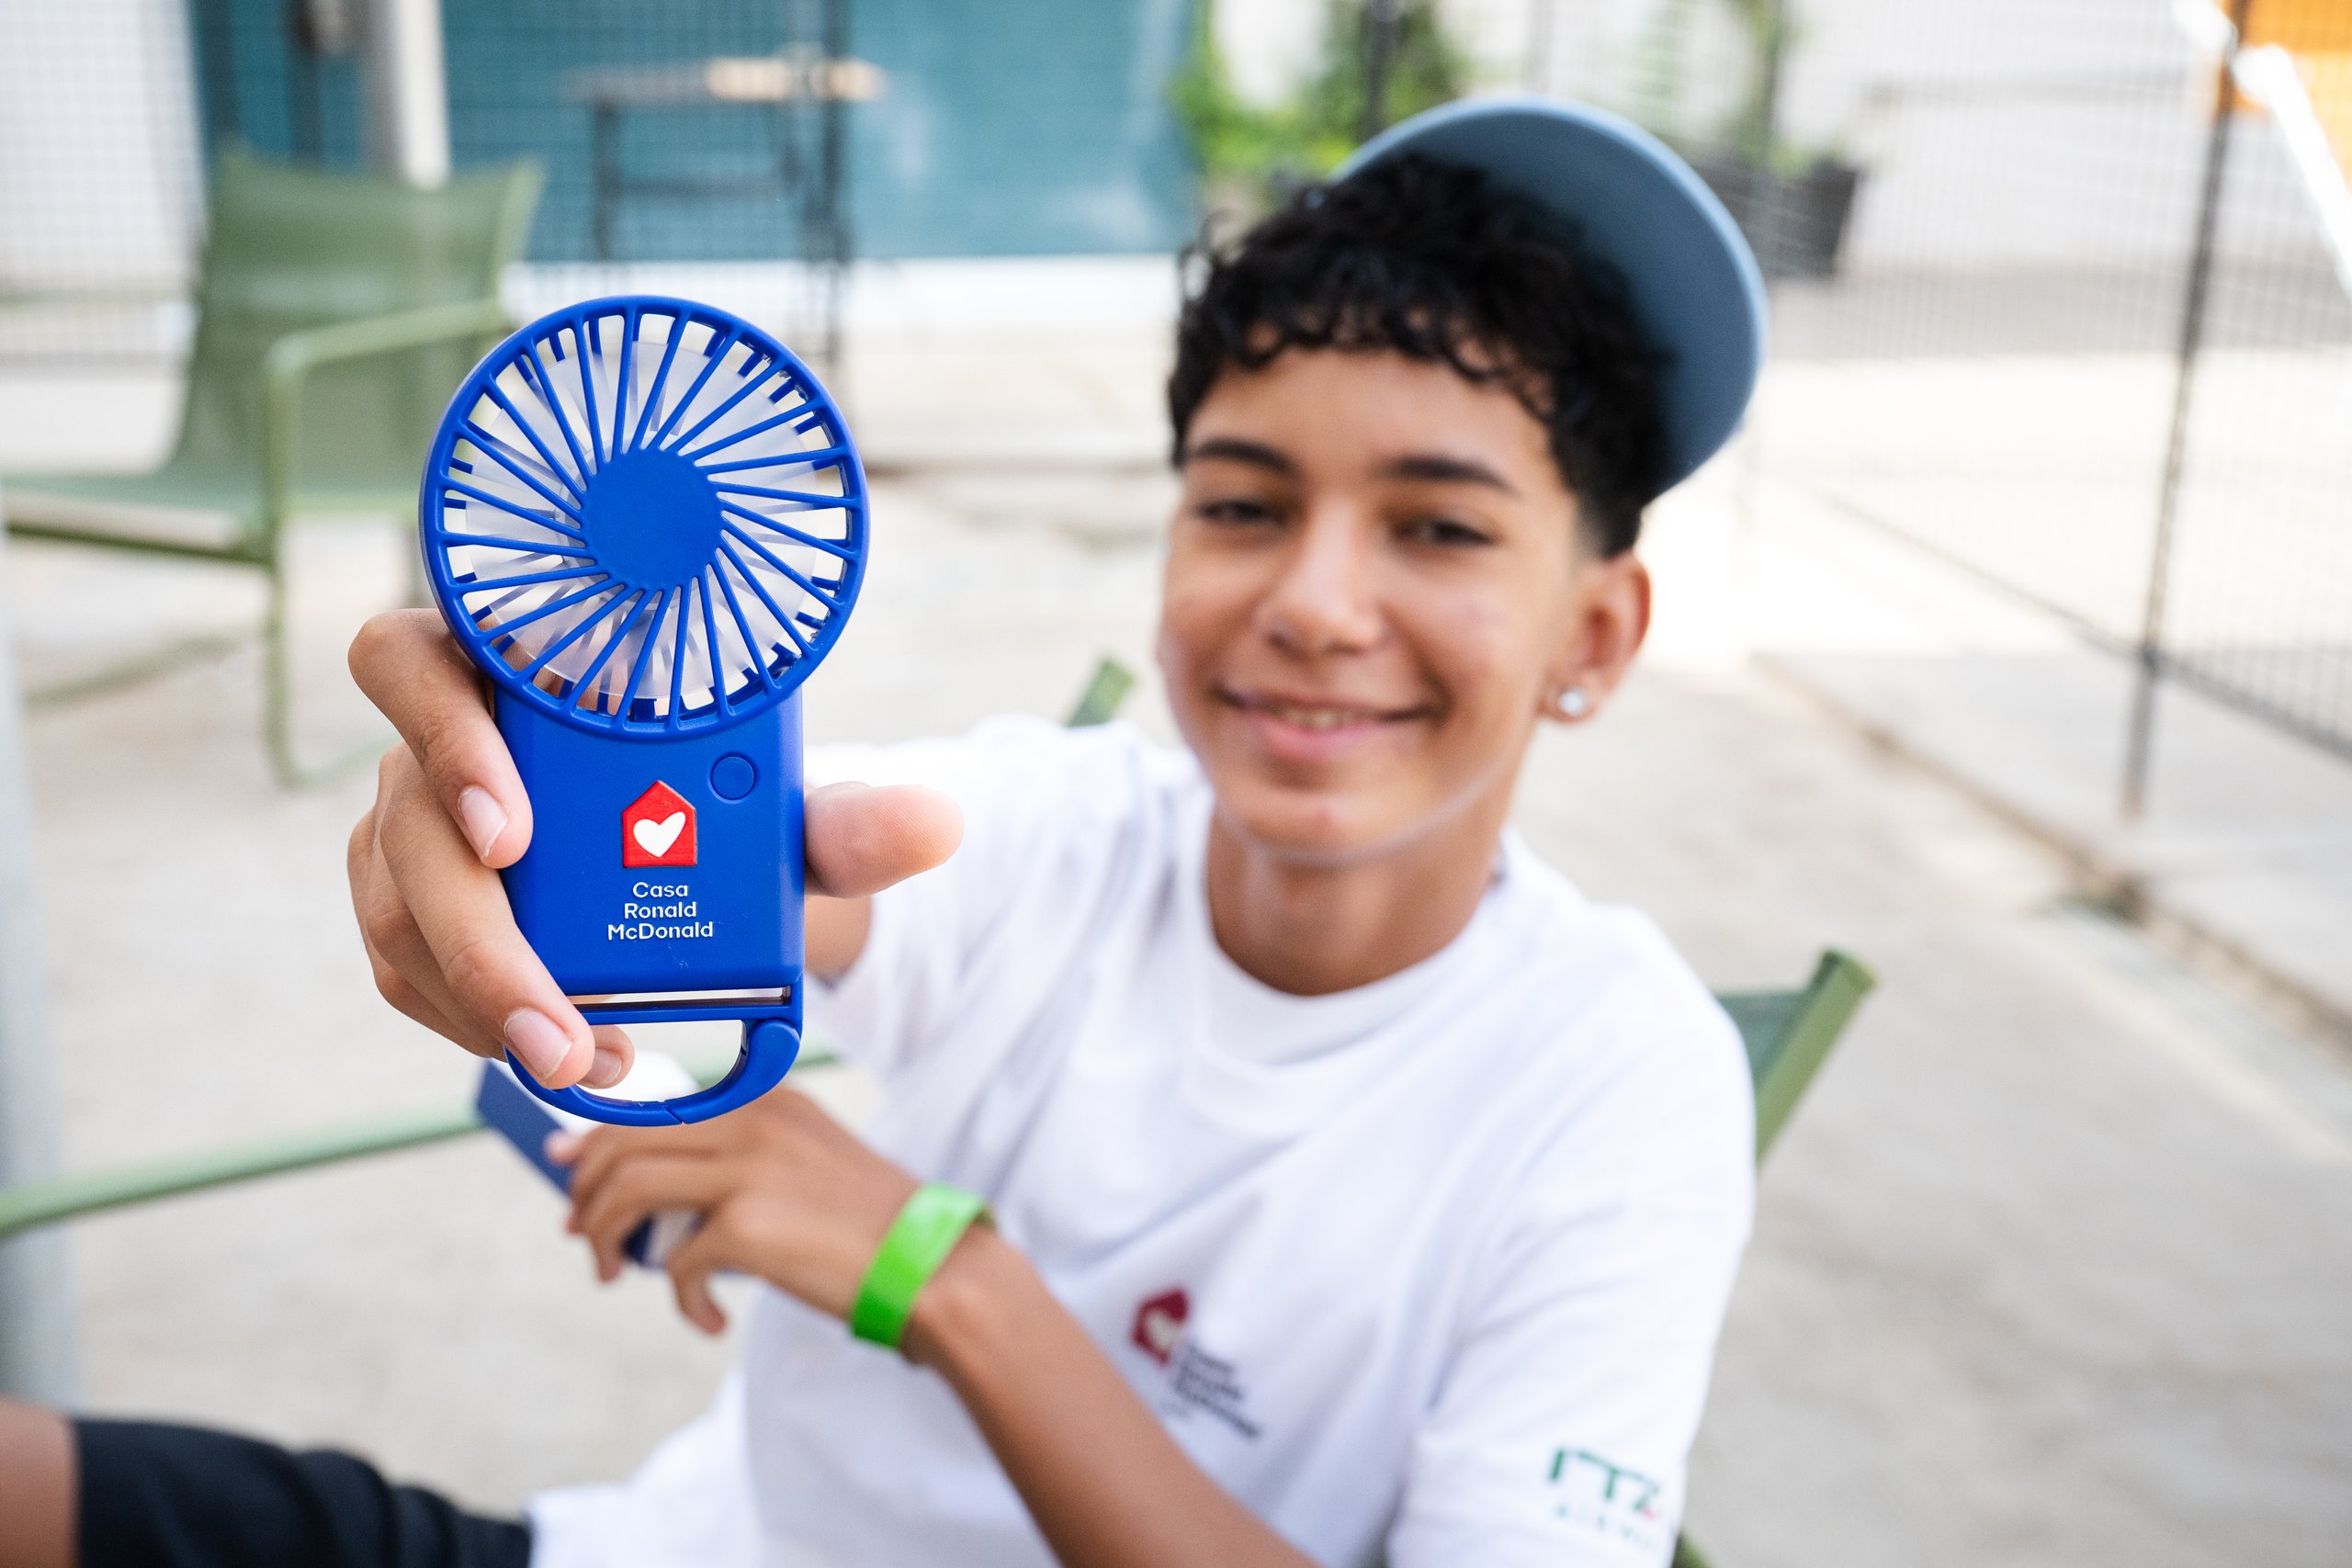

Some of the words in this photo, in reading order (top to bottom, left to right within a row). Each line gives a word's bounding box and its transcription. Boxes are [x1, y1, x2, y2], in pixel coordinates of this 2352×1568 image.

[632, 881, 688, 898] Casa
[624, 901, 697, 919] Ronald
[607, 921, 714, 941] McDonald
